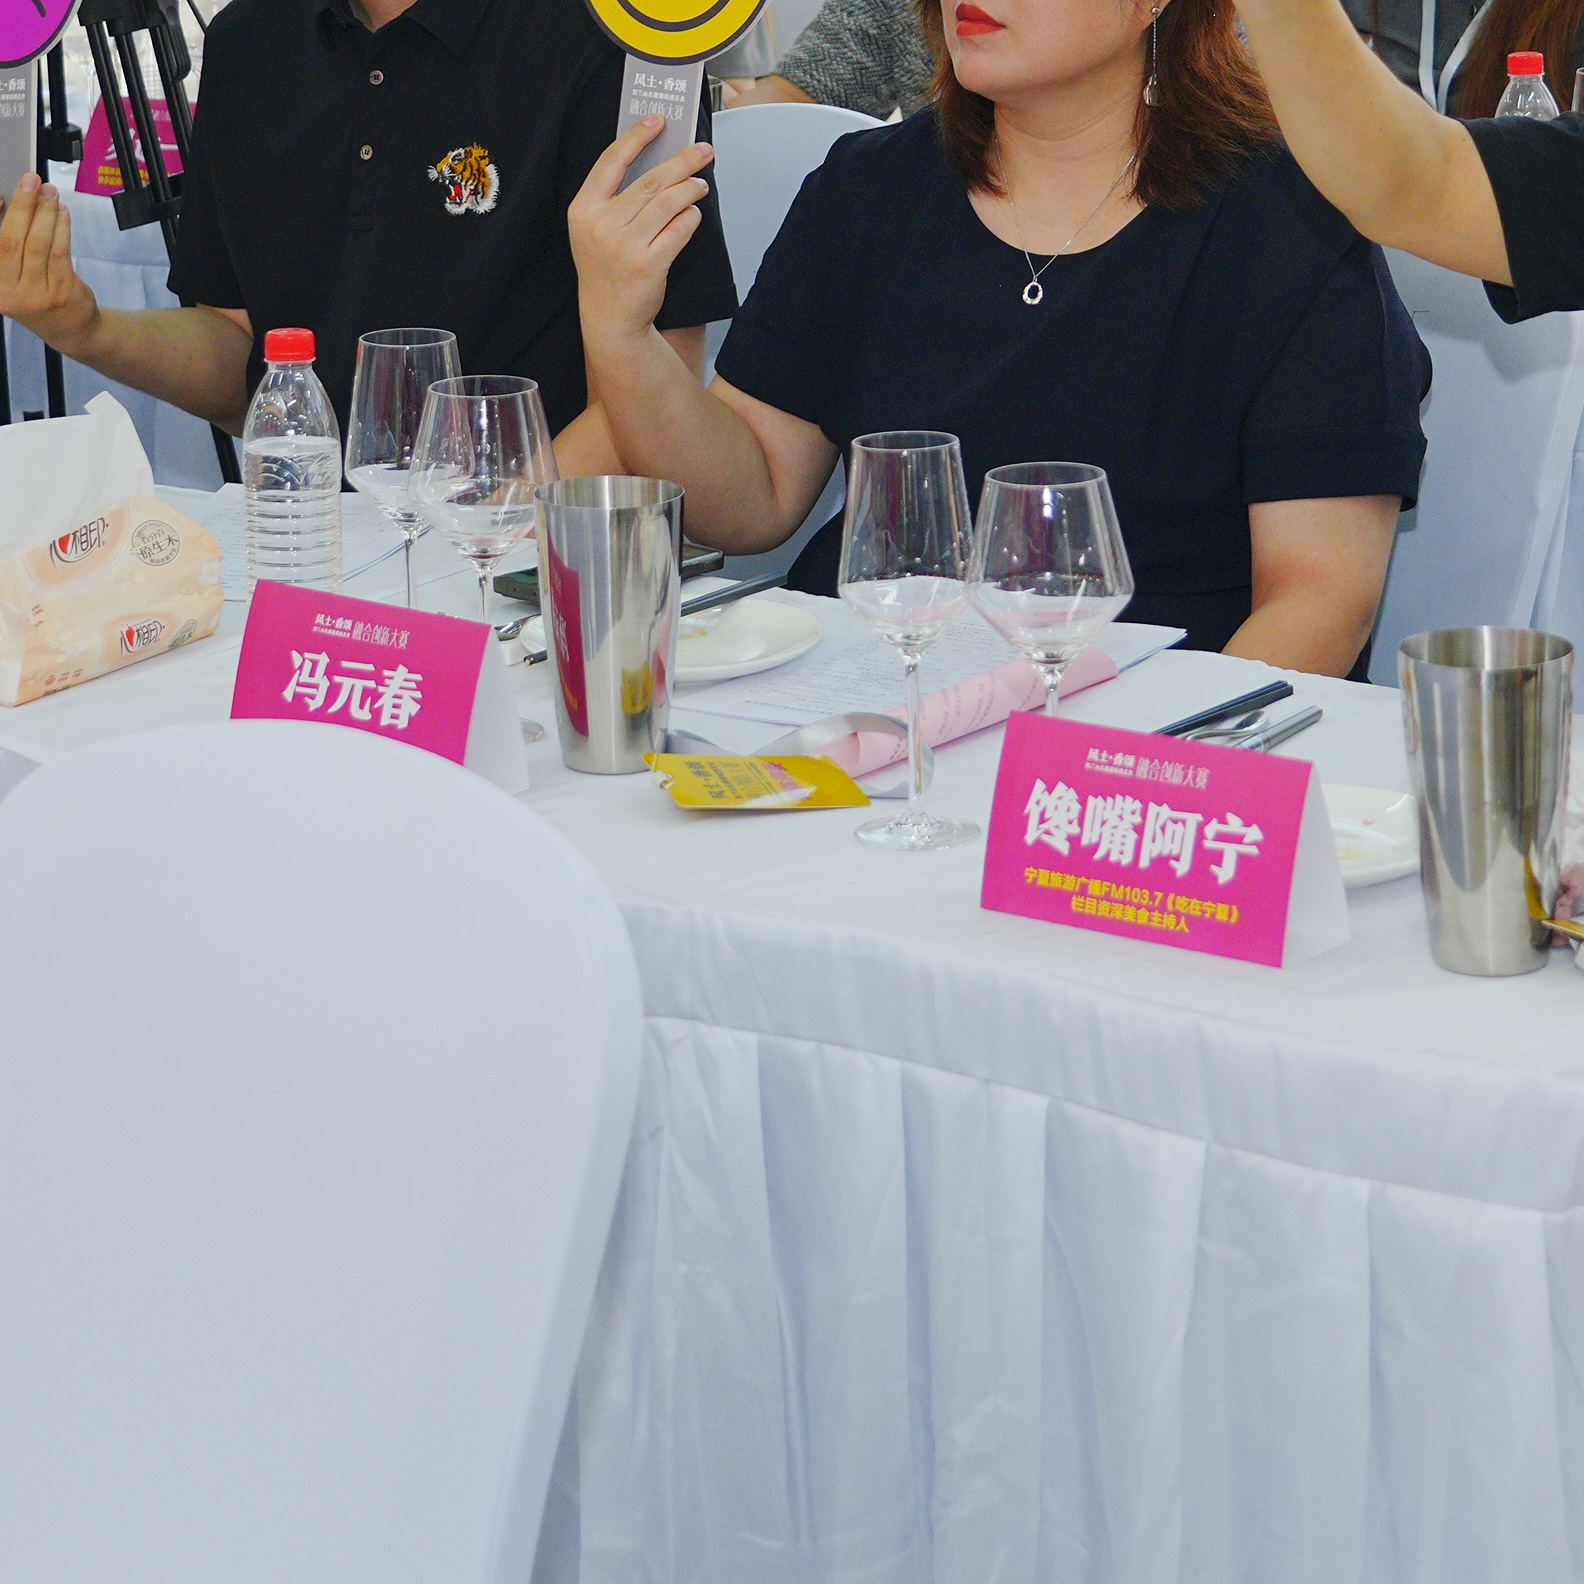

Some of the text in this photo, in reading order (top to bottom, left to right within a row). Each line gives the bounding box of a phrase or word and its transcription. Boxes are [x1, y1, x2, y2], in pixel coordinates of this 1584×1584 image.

[633, 72, 688, 93] 风土·香颂
[136, 534, 178, 560] 原生木
[282, 649, 424, 730] 冯元春
[1023, 777, 1264, 885] 馋嘴阿宁
